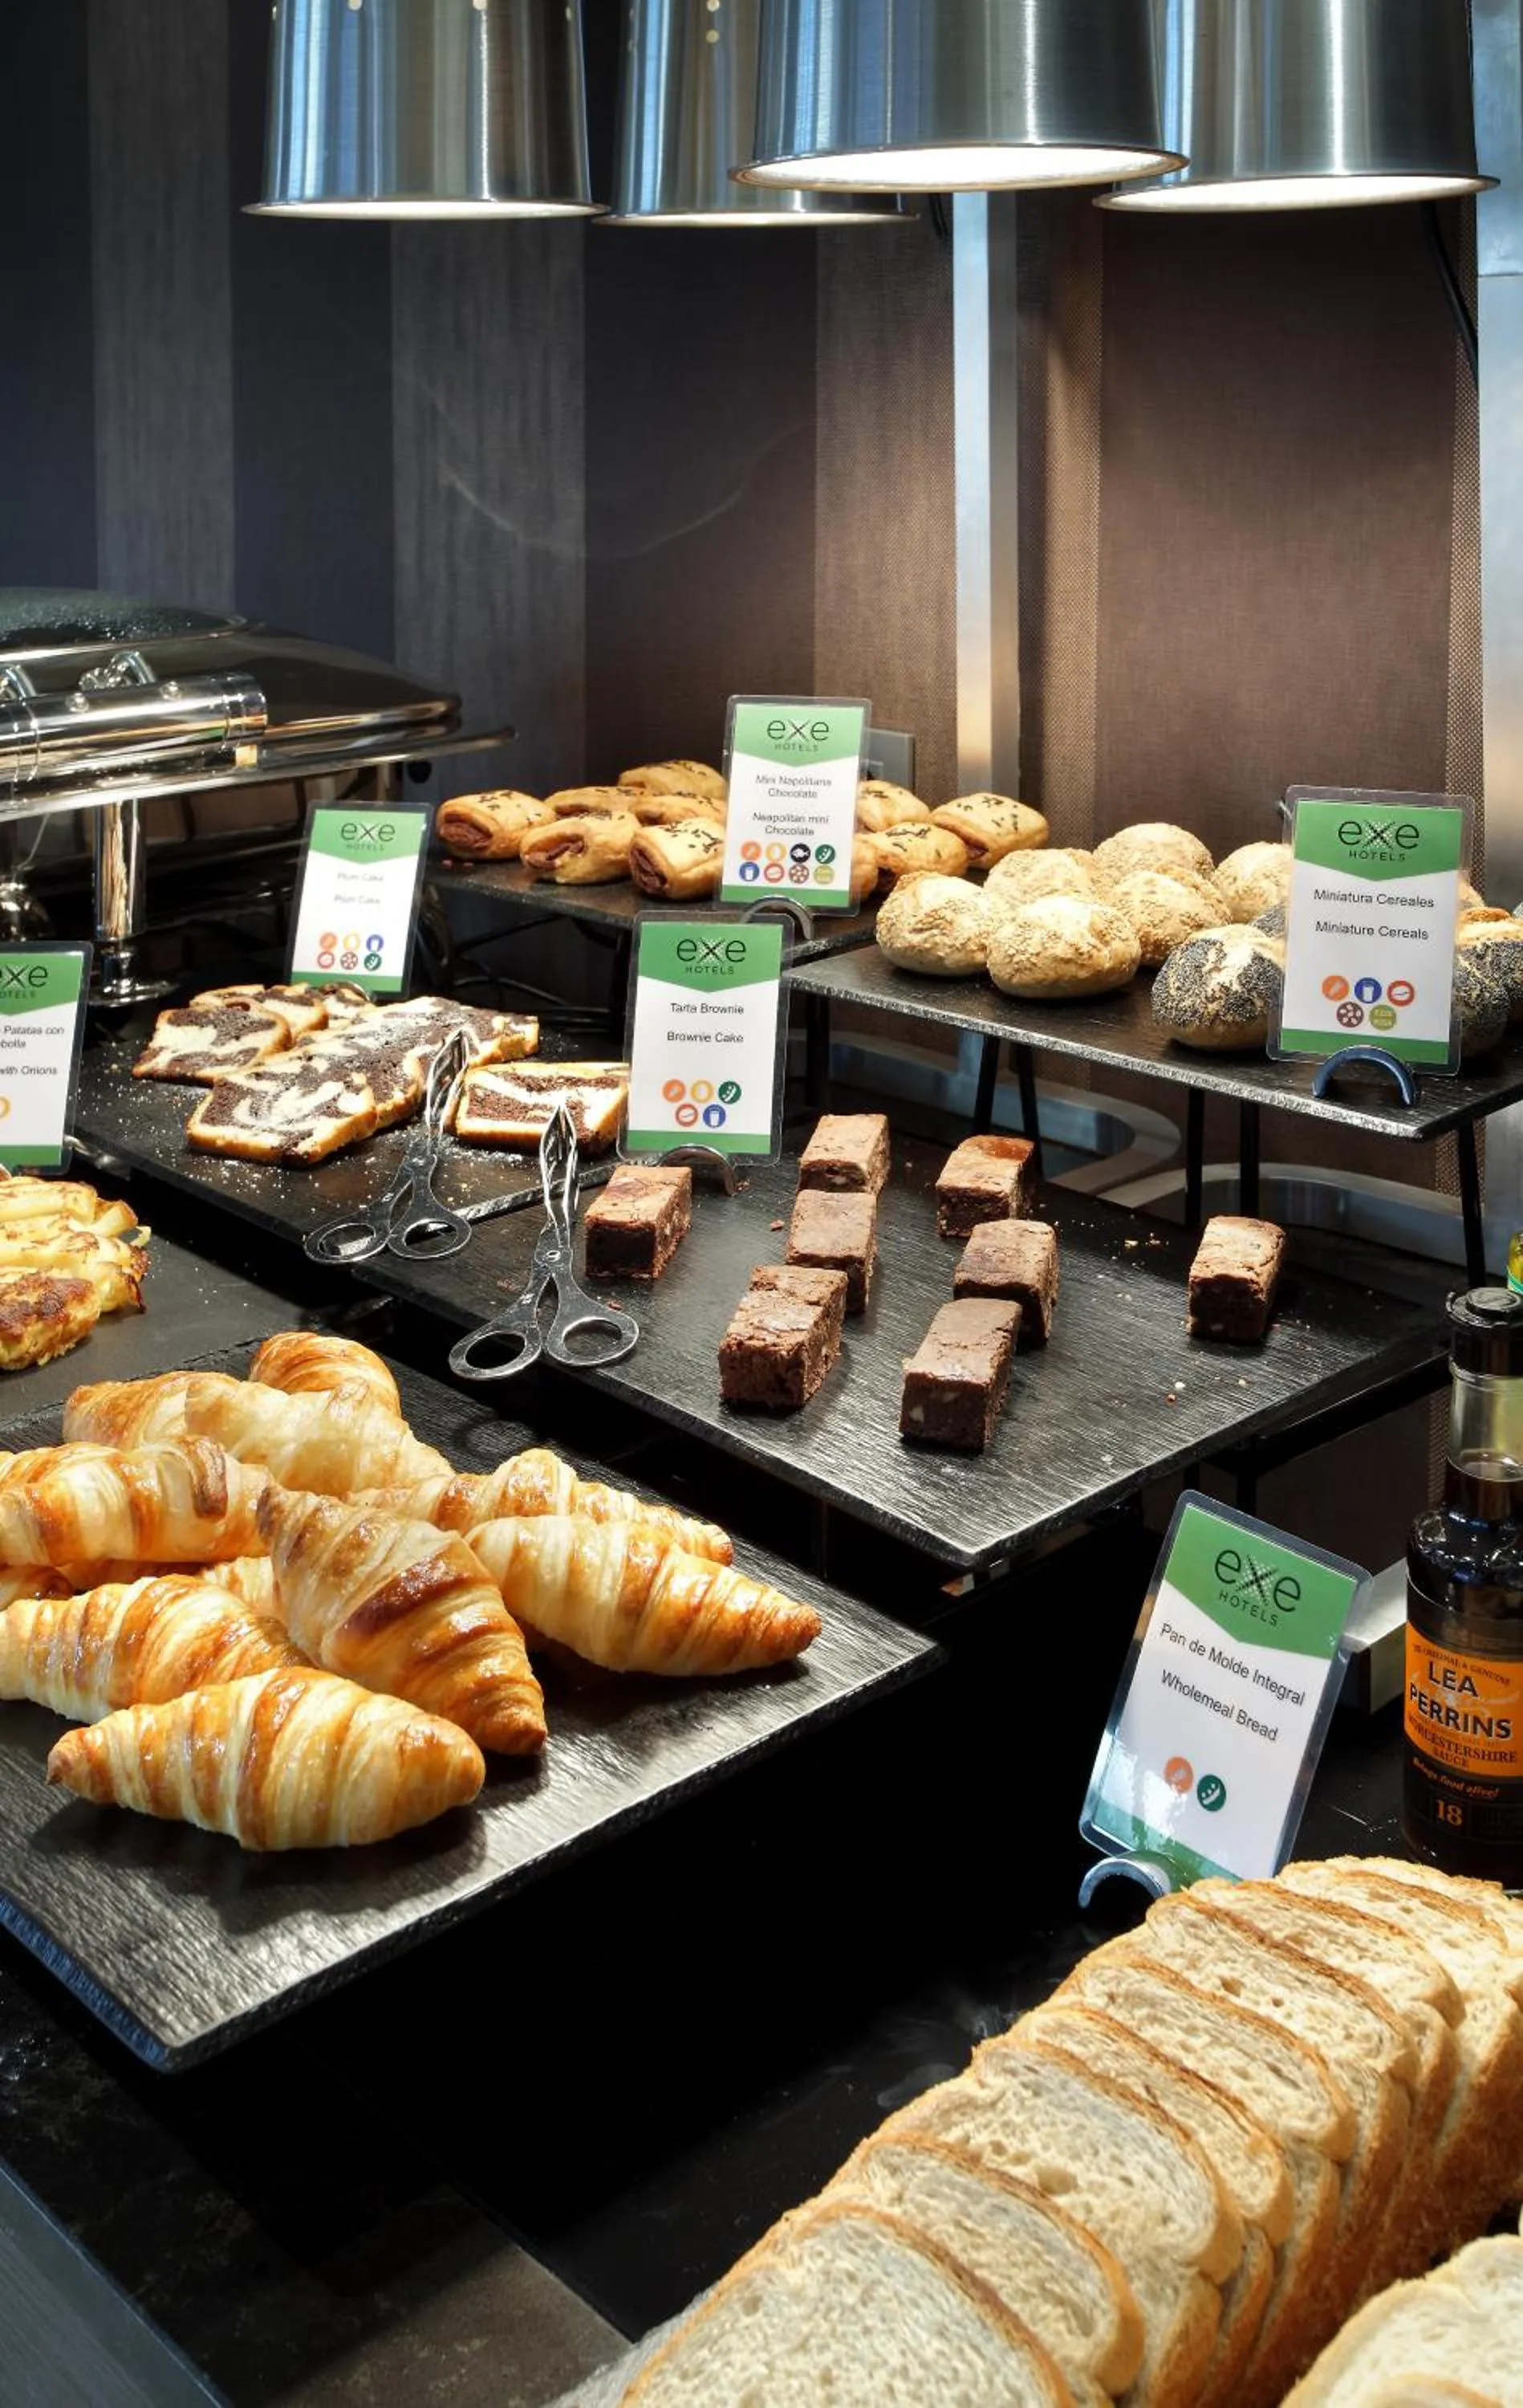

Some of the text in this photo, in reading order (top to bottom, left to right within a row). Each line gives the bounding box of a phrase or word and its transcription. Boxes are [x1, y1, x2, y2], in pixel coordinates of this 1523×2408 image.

[766, 719, 829, 741] exe
[774, 743, 818, 752] HOTELS
[768, 788, 818, 798] Chocolate
[753, 812, 829, 823] Neapolitan mini
[340, 822, 396, 842] exe
[765, 824, 814, 836] Chocolate
[1338, 820, 1420, 851] exe
[347, 844, 385, 852] HOTELS
[1348, 850, 1405, 862] HOTELS
[1376, 893, 1435, 909] Cereales
[1314, 921, 1429, 941] Miniature Cereals
[676, 937, 746, 964] exe
[0, 963, 48, 988] xe
[684, 966, 735, 975] HOTELS
[0, 990, 36, 1000] OTELS
[670, 1003, 744, 1015] Tarta Brownie
[4, 1025, 65, 1035] Patatas con
[667, 1031, 744, 1043] Brownie Cake
[0, 1038, 26, 1048] bolla
[21, 1065, 57, 1076] Onions
[1214, 1549, 1302, 1613] exe
[1218, 1590, 1279, 1627] HOTELS
[1160, 1622, 1306, 1708] Pan de Molde Integral
[1428, 1660, 1479, 1698] LEA
[1161, 1670, 1279, 1742] Wholemeal Bread
[1410, 1682, 1513, 1739] PERRINS
